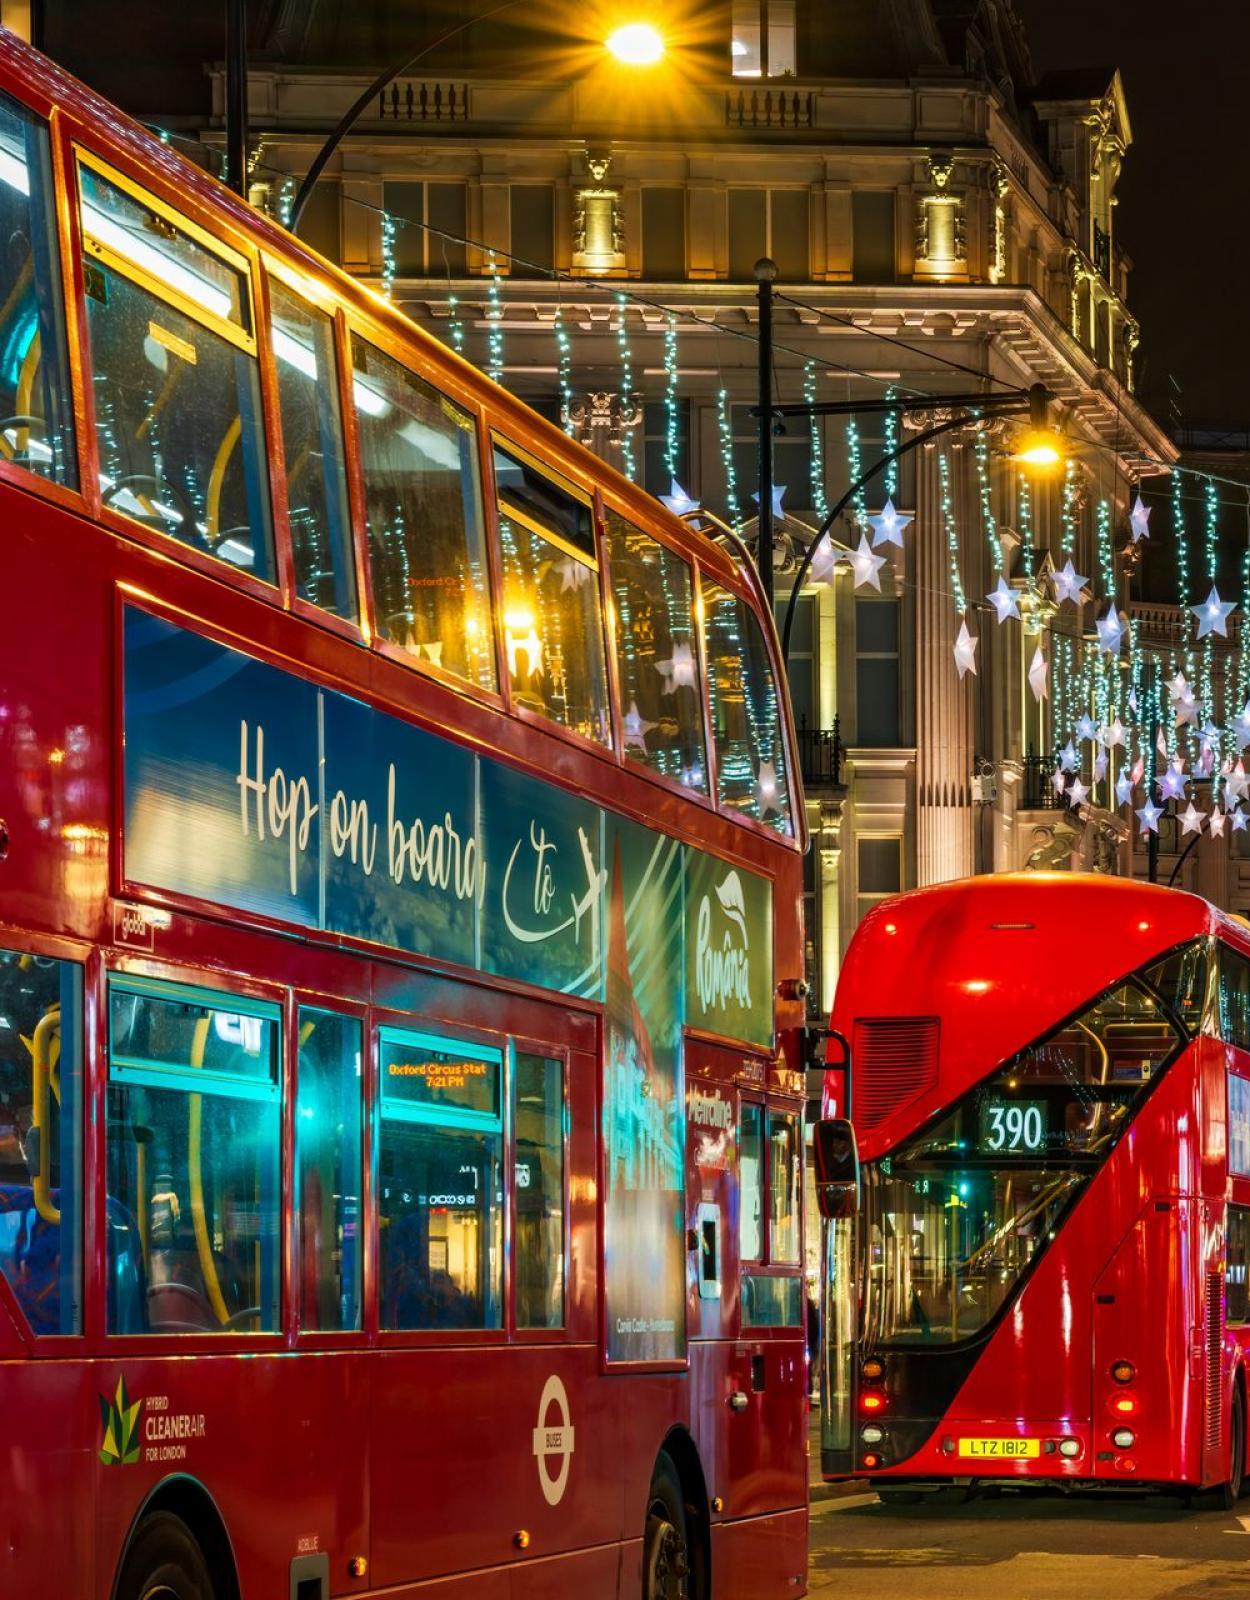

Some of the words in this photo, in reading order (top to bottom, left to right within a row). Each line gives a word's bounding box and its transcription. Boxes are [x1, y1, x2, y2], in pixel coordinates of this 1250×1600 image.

[236, 719, 319, 896] Hop
[330, 789, 377, 876] on
[389, 1063, 426, 1075] Oxford
[428, 1063, 461, 1075] Circus
[463, 1063, 486, 1075] Stat
[426, 1076, 447, 1087] 7:21
[448, 1076, 465, 1087] PM
[989, 1107, 1042, 1149] 390
[146, 1396, 169, 1411] HYBRID
[546, 1432, 562, 1448] BUSES
[971, 1441, 998, 1454] LTZ
[1002, 1441, 1028, 1454] 1812
[146, 1447, 158, 1462] FOR
[160, 1445, 186, 1460] LONDON
